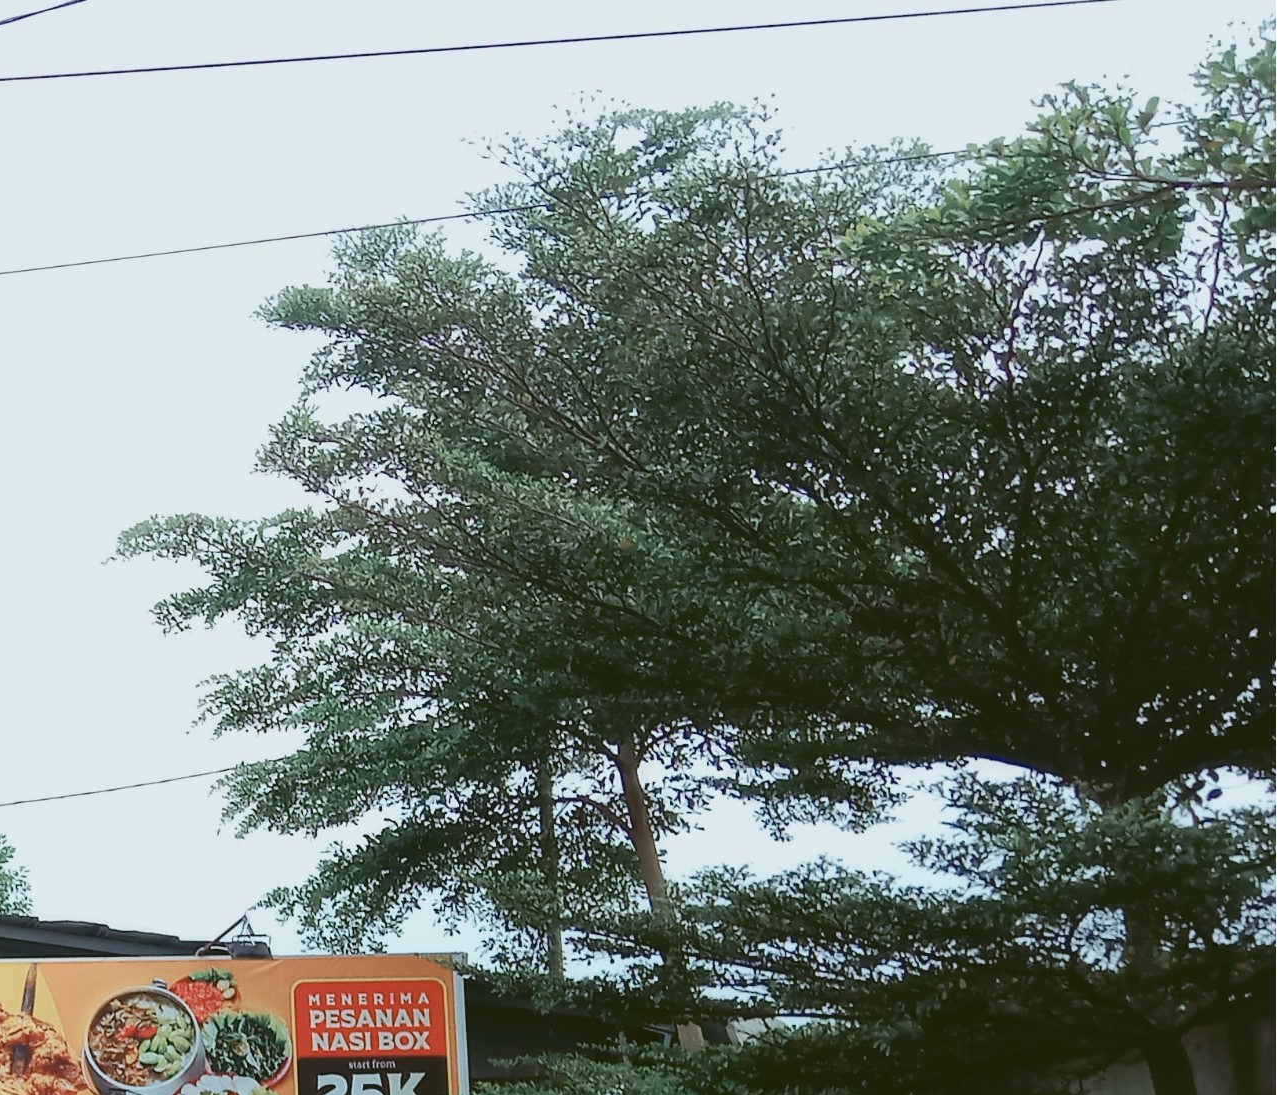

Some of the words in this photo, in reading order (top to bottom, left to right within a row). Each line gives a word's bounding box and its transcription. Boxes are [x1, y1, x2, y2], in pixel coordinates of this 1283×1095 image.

[308, 992, 430, 1006] MENERIMA
[309, 1008, 431, 1028] PESANAN
[311, 1032, 371, 1051] NASI
[378, 1031, 430, 1050] BOX
[348, 1060, 370, 1070] start
[372, 1059, 396, 1069] from
